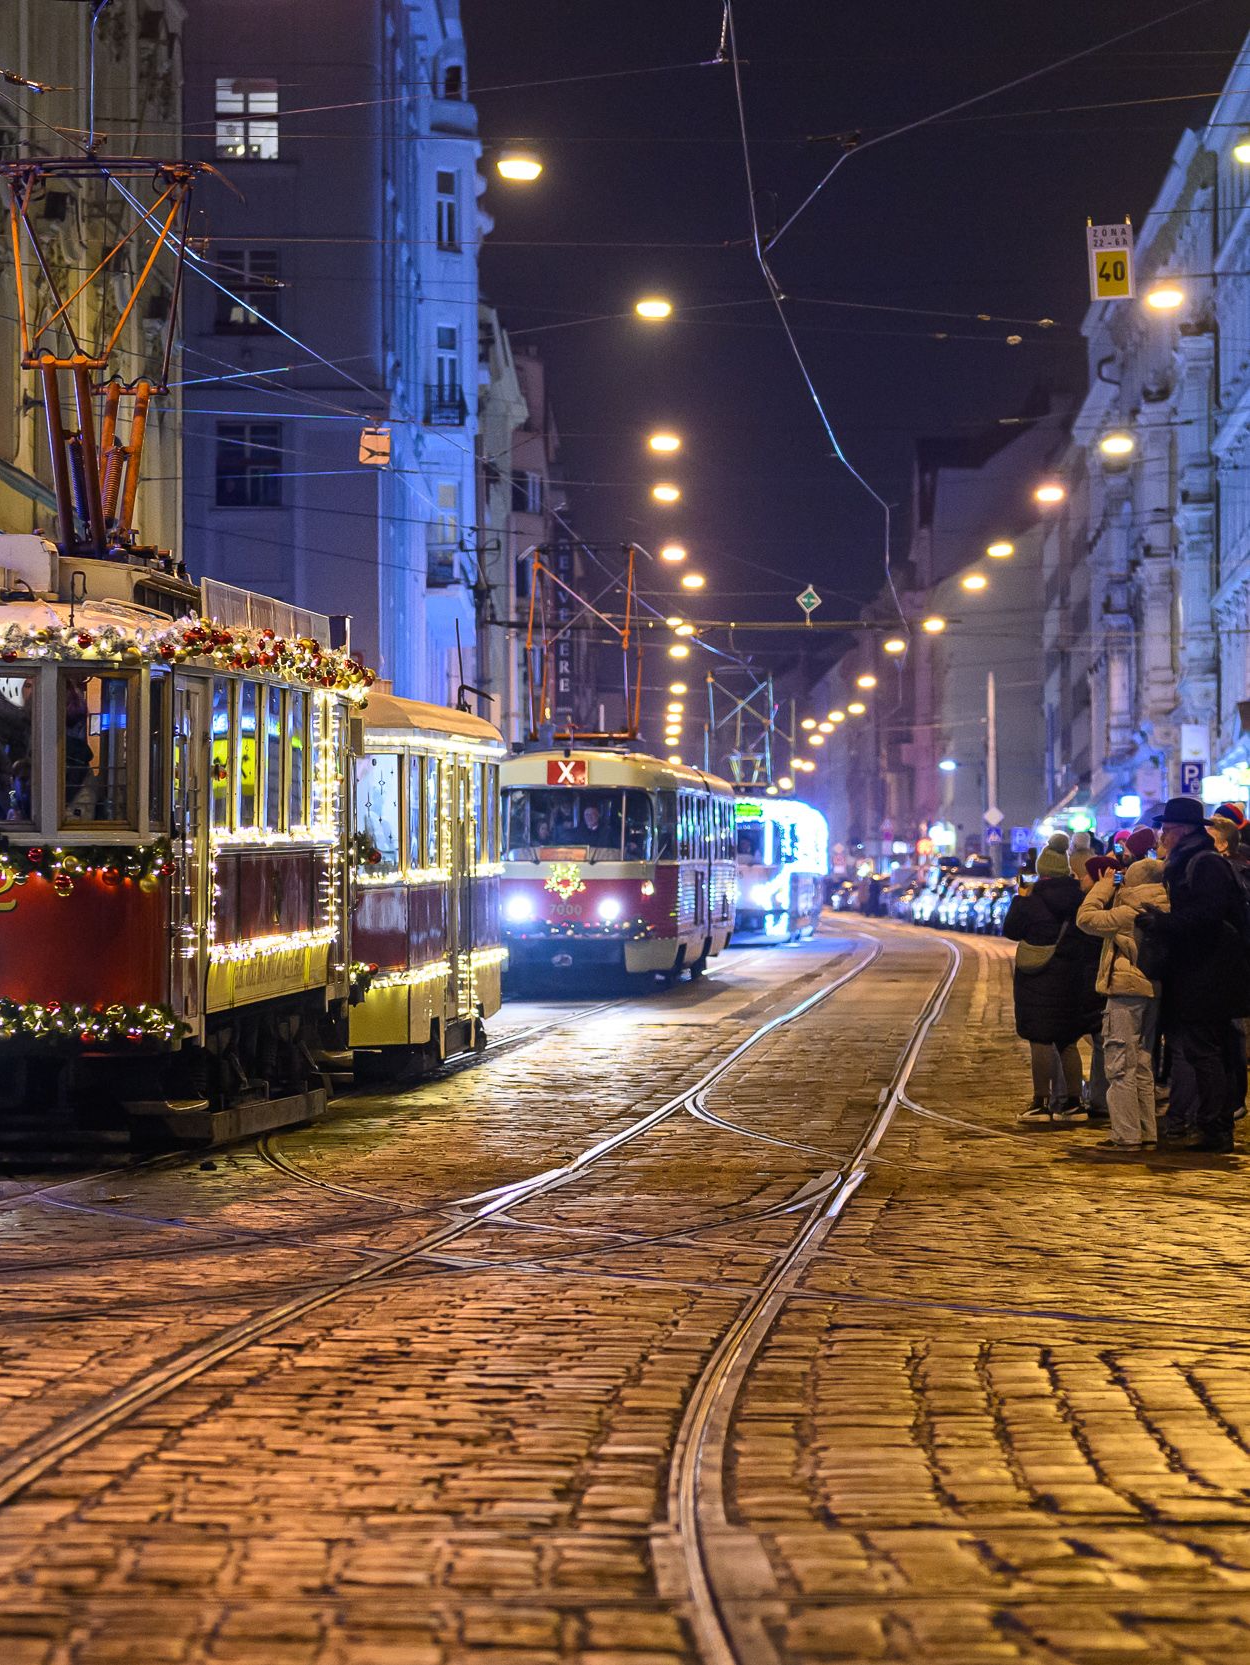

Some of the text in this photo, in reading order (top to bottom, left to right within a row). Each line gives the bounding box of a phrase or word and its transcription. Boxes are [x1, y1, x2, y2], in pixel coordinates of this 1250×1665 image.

[1093, 228, 1127, 238] ZONA
[1099, 260, 1126, 282] 40
[557, 761, 576, 784] X
[1184, 765, 1200, 785] P
[549, 903, 583, 916] 7000
